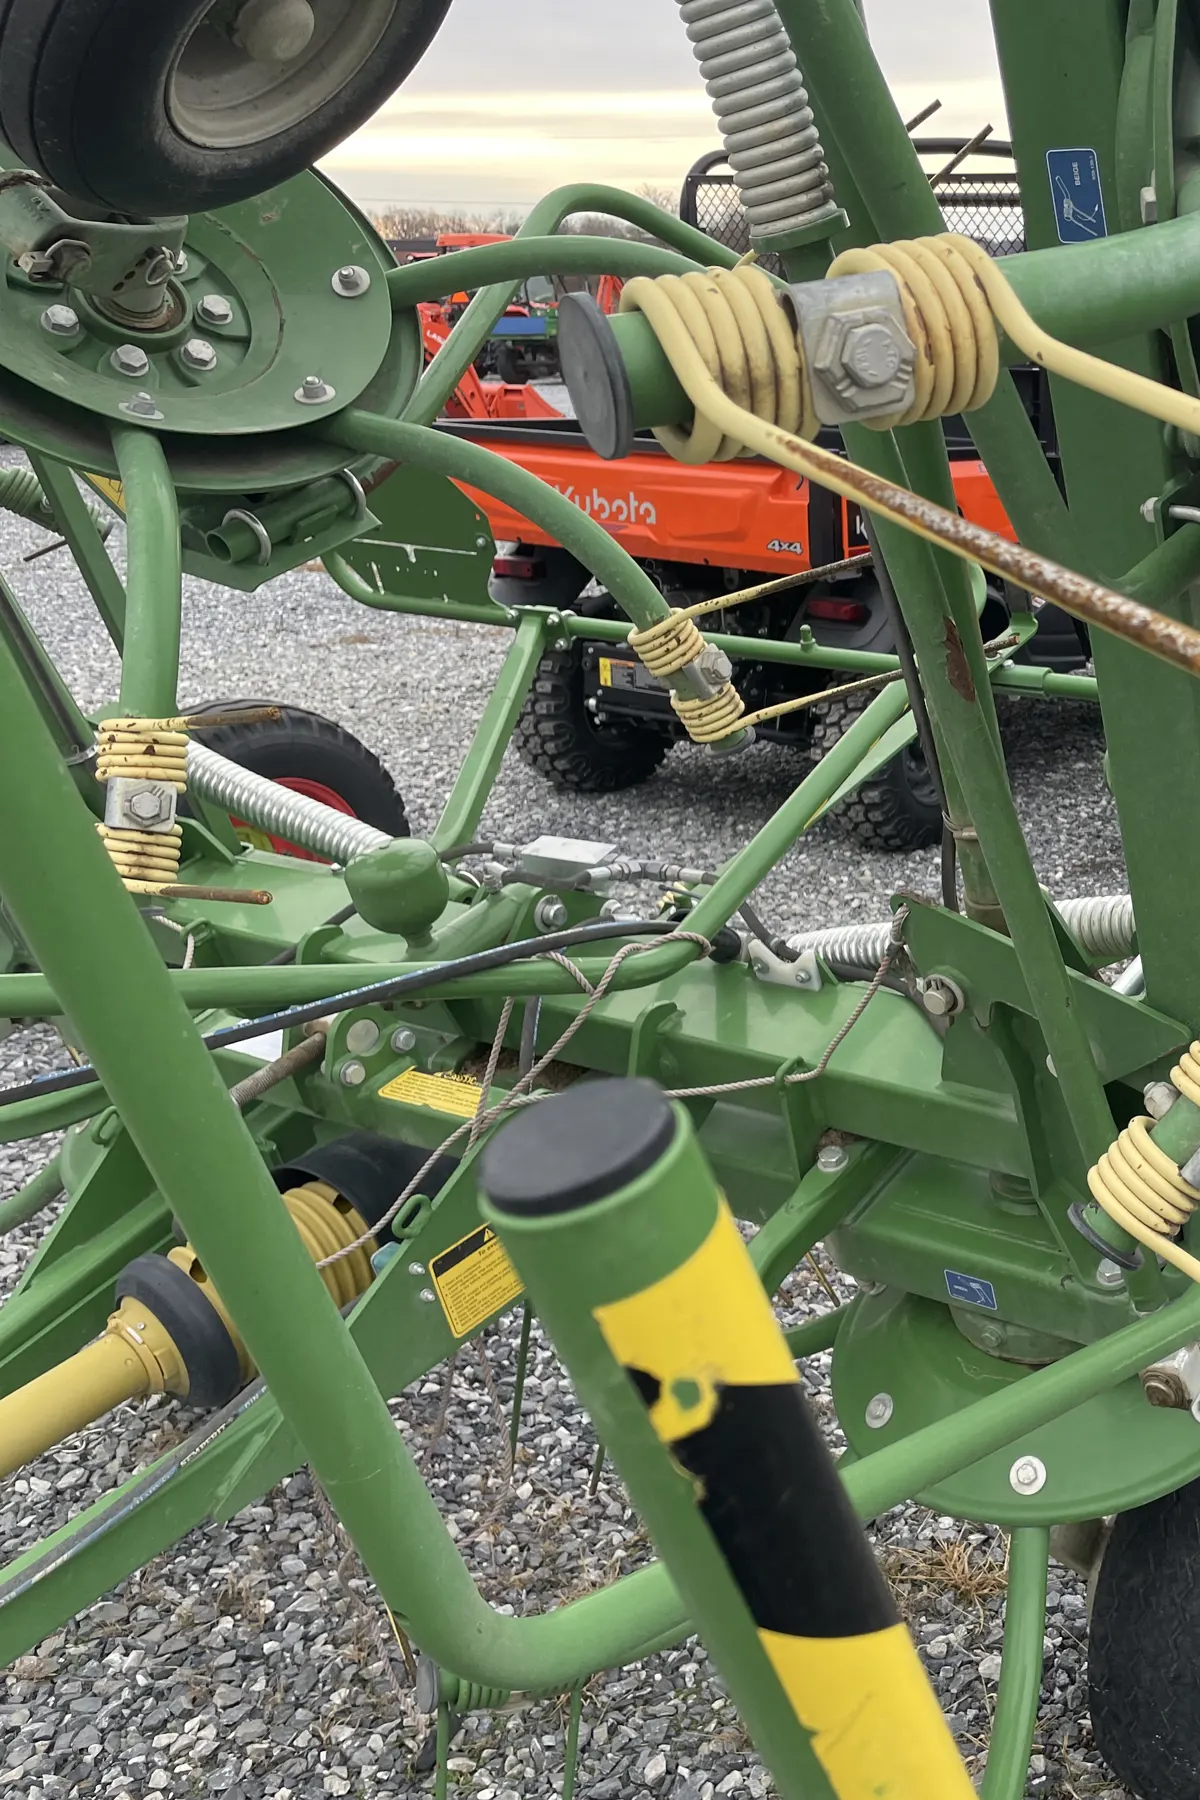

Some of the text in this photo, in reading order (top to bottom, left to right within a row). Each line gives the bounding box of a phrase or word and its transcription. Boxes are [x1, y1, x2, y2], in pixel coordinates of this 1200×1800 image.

[1071, 161, 1081, 186] BEIGE
[766, 539, 803, 555] 4x4
[180, 1423, 226, 1467] SEMPERIT
